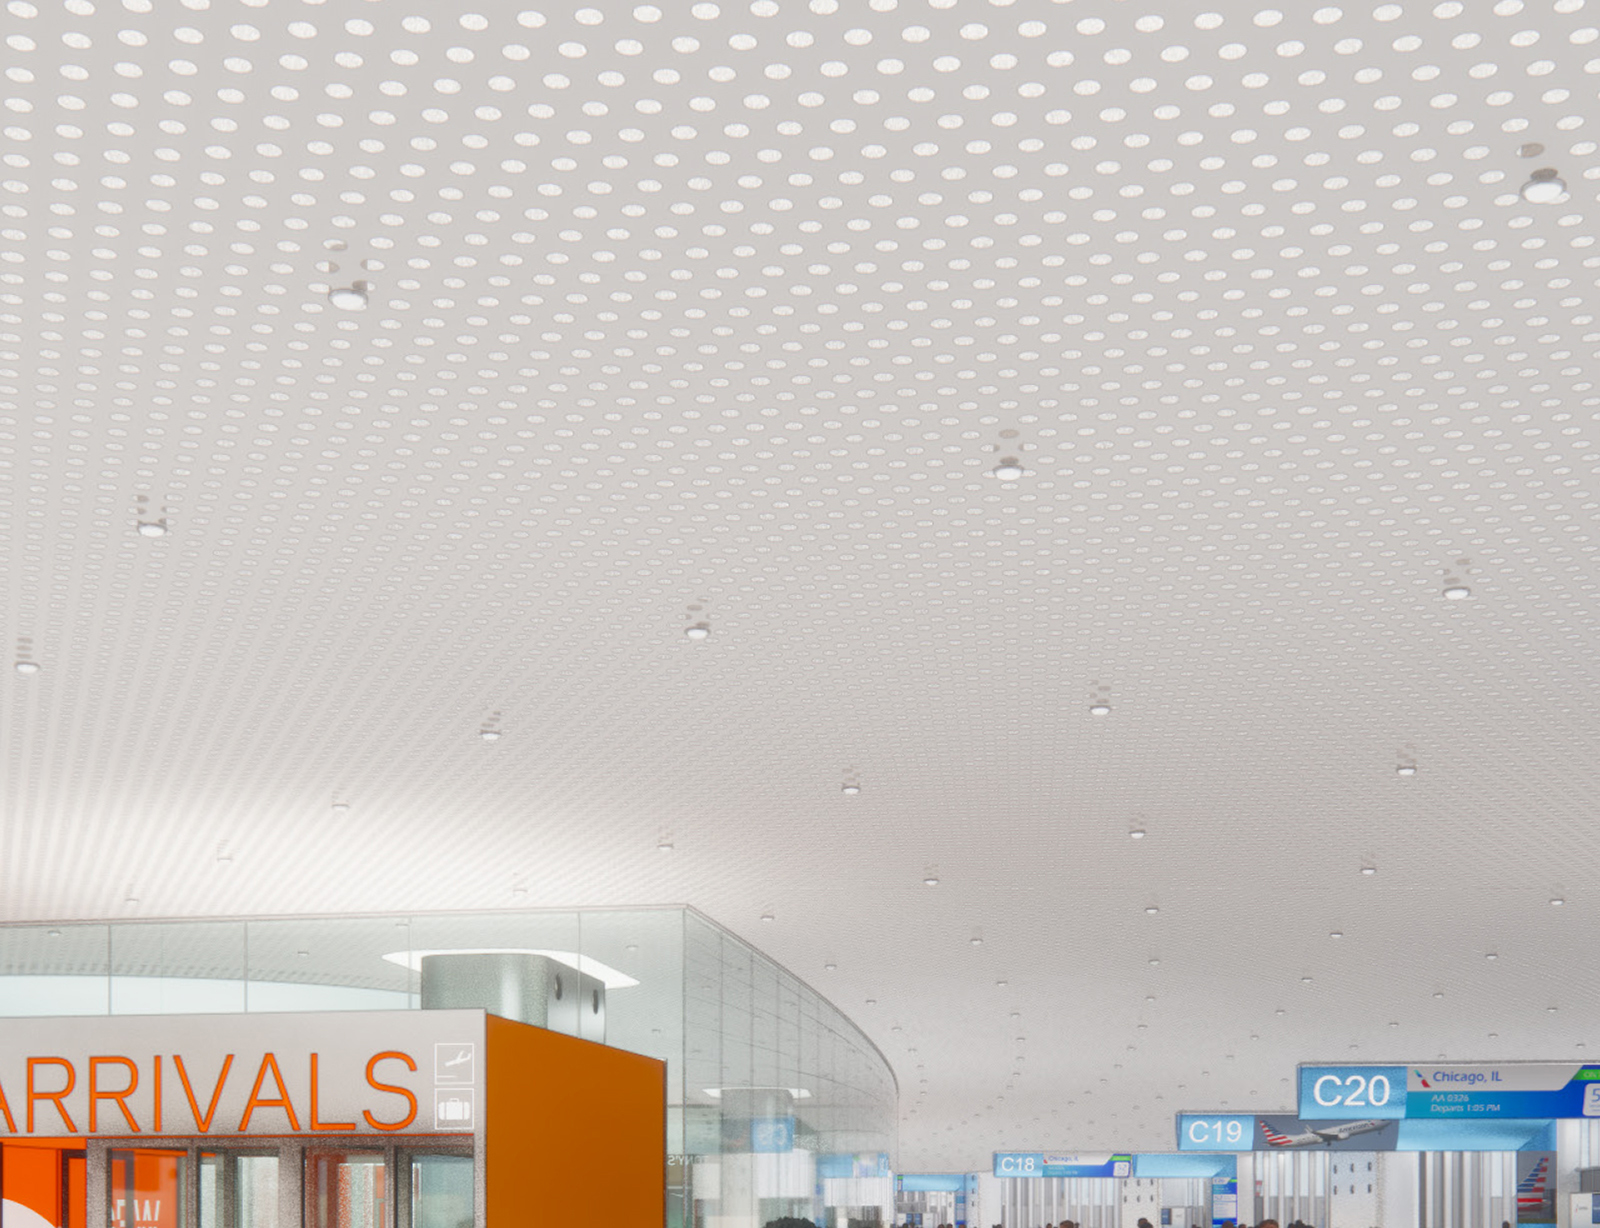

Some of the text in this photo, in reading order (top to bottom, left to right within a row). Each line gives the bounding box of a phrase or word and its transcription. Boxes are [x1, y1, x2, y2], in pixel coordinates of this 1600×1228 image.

[1432, 1071, 1503, 1086] Chicago, IL
[1313, 1074, 1390, 1107] C20
[1430, 1103, 1464, 1114] Departs
[1188, 1120, 1243, 1143] C19
[1001, 1157, 1035, 1172] C18
